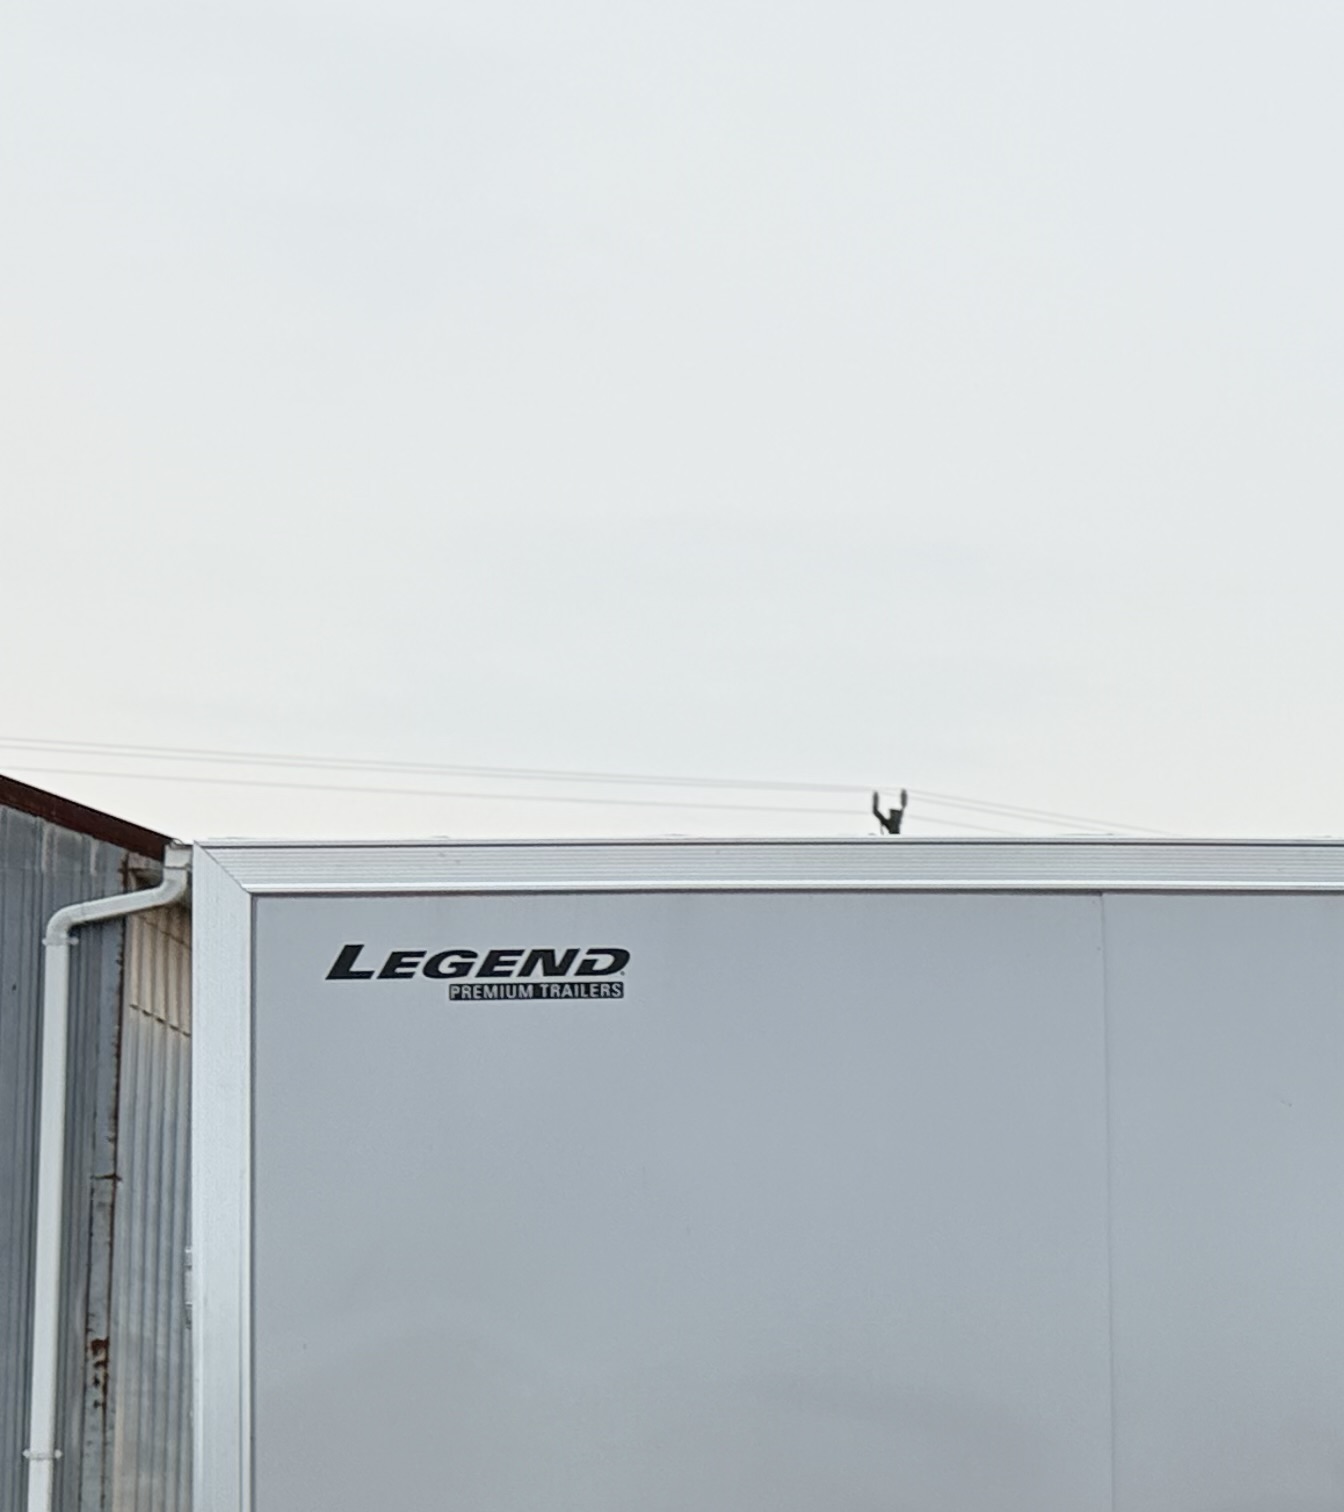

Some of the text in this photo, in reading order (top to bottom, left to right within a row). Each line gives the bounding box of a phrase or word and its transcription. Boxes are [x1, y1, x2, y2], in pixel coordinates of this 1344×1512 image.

[325, 944, 631, 980] LEGEND
[450, 983, 622, 1000] PREMIUM TRAILERS
